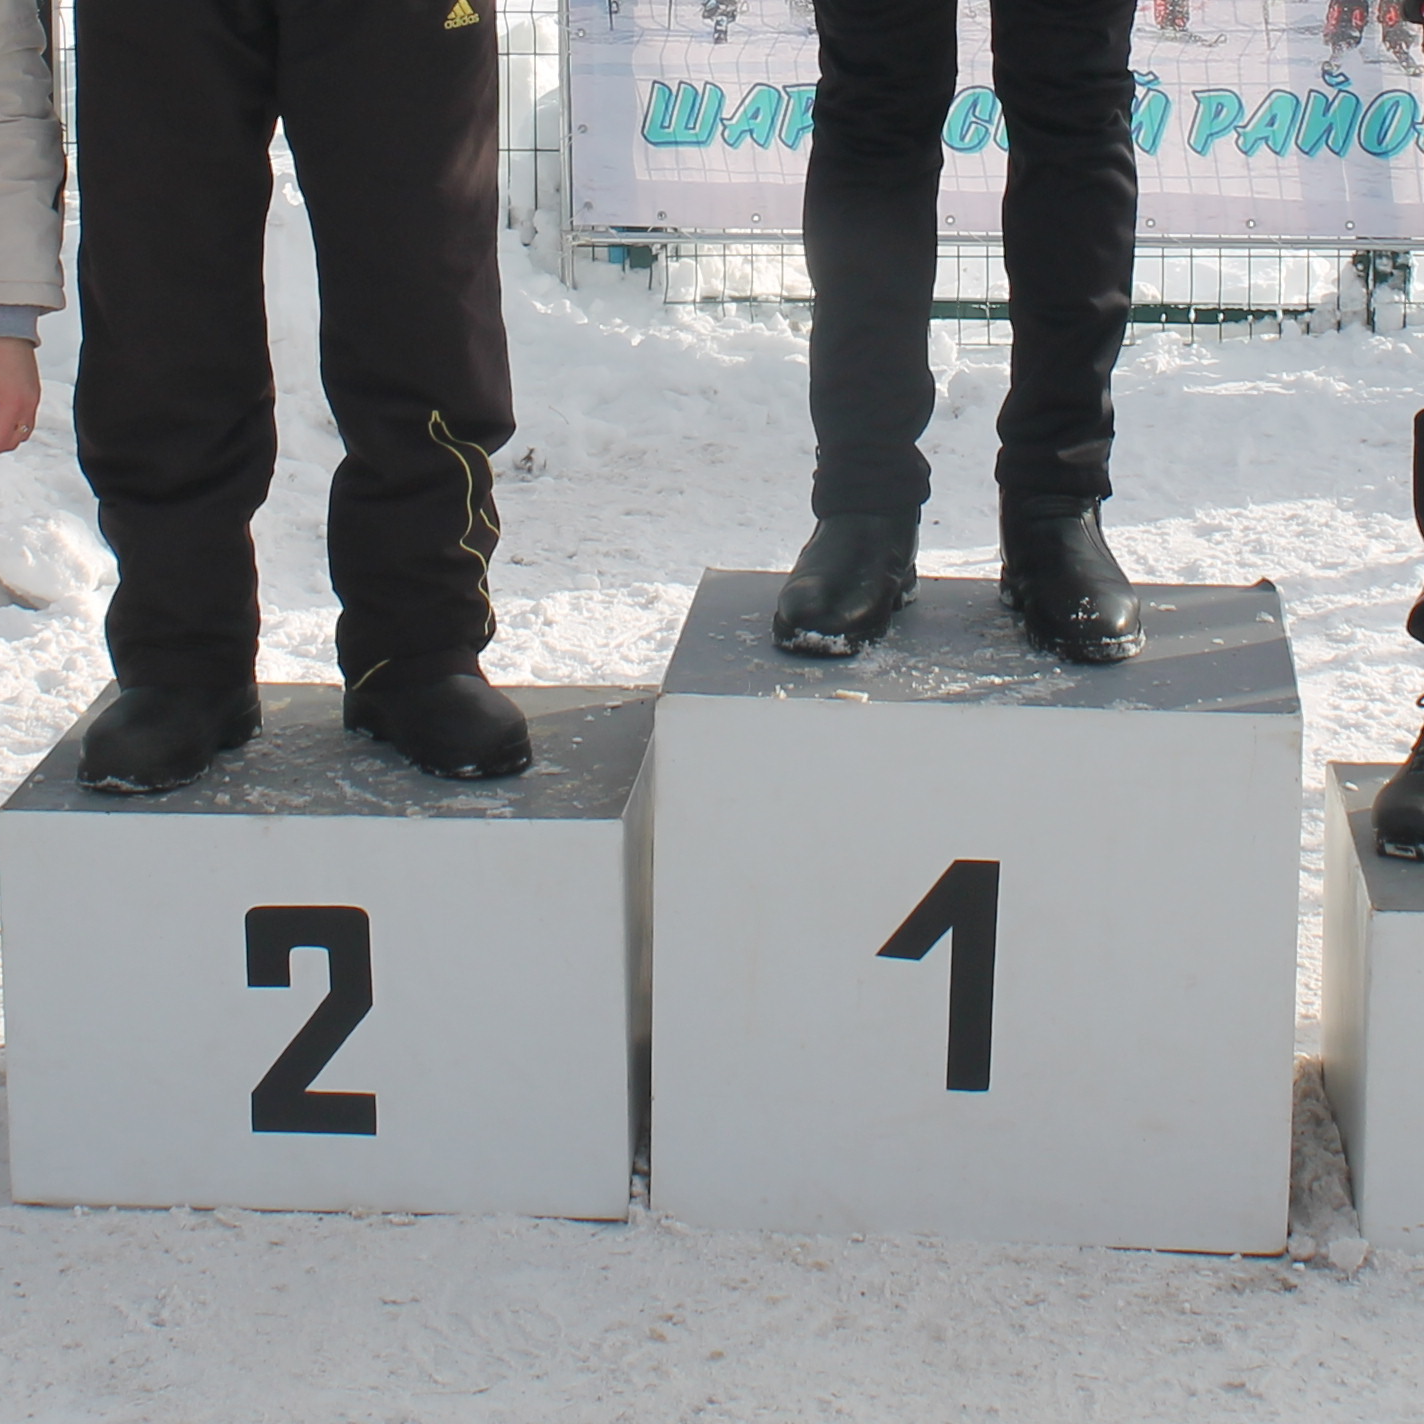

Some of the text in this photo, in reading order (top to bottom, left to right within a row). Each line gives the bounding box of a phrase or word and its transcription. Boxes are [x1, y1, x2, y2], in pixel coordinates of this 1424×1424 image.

[444, 13, 480, 29] adidas
[245, 905, 377, 1136] 2
[876, 859, 1000, 1092] 1
